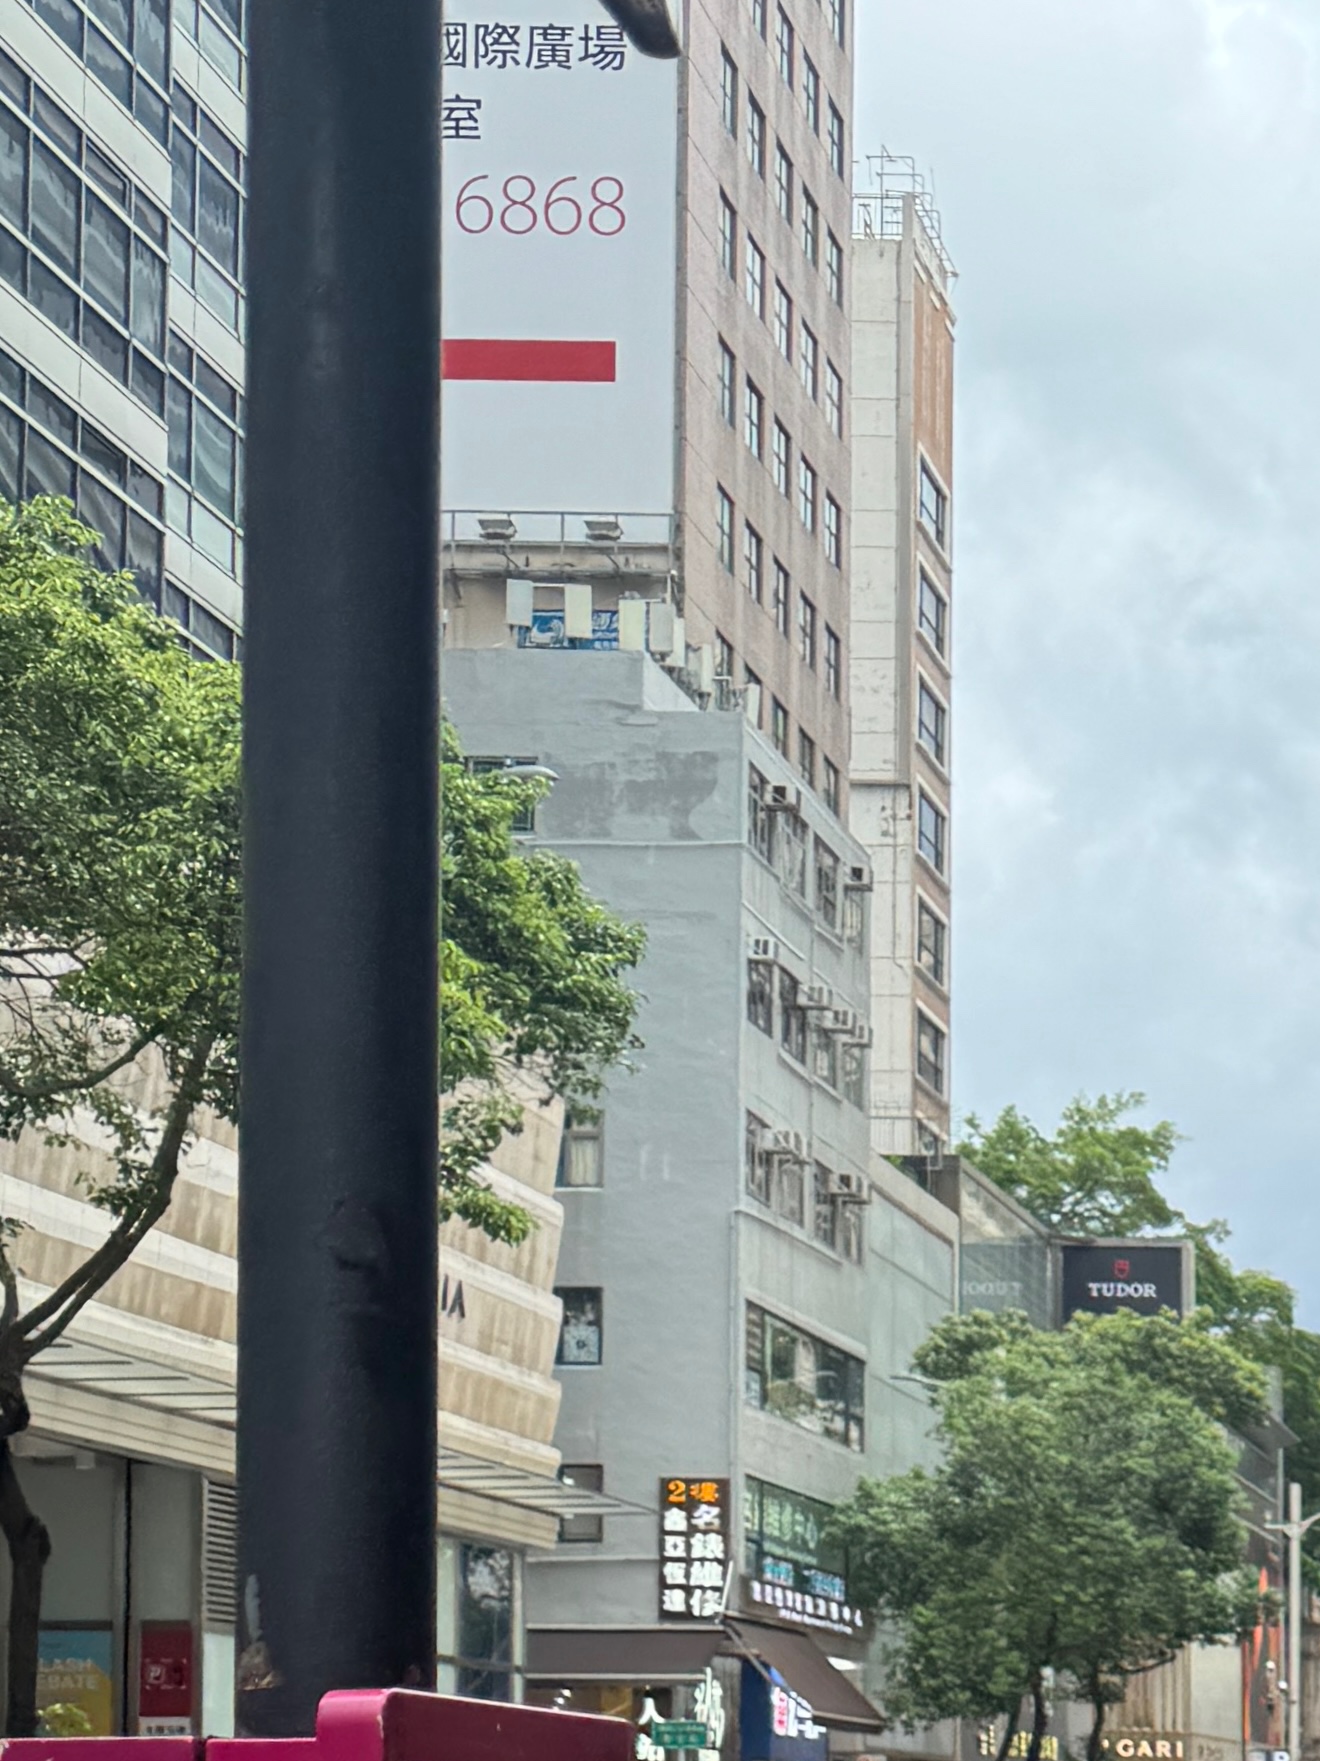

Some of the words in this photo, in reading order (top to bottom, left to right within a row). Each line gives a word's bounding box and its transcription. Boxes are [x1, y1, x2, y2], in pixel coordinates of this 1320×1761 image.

[443, 22, 627, 71] 國際廣場
[442, 94, 482, 140] 室
[456, 175, 626, 236] 6868
[1088, 1282, 1157, 1298] TUDOR
